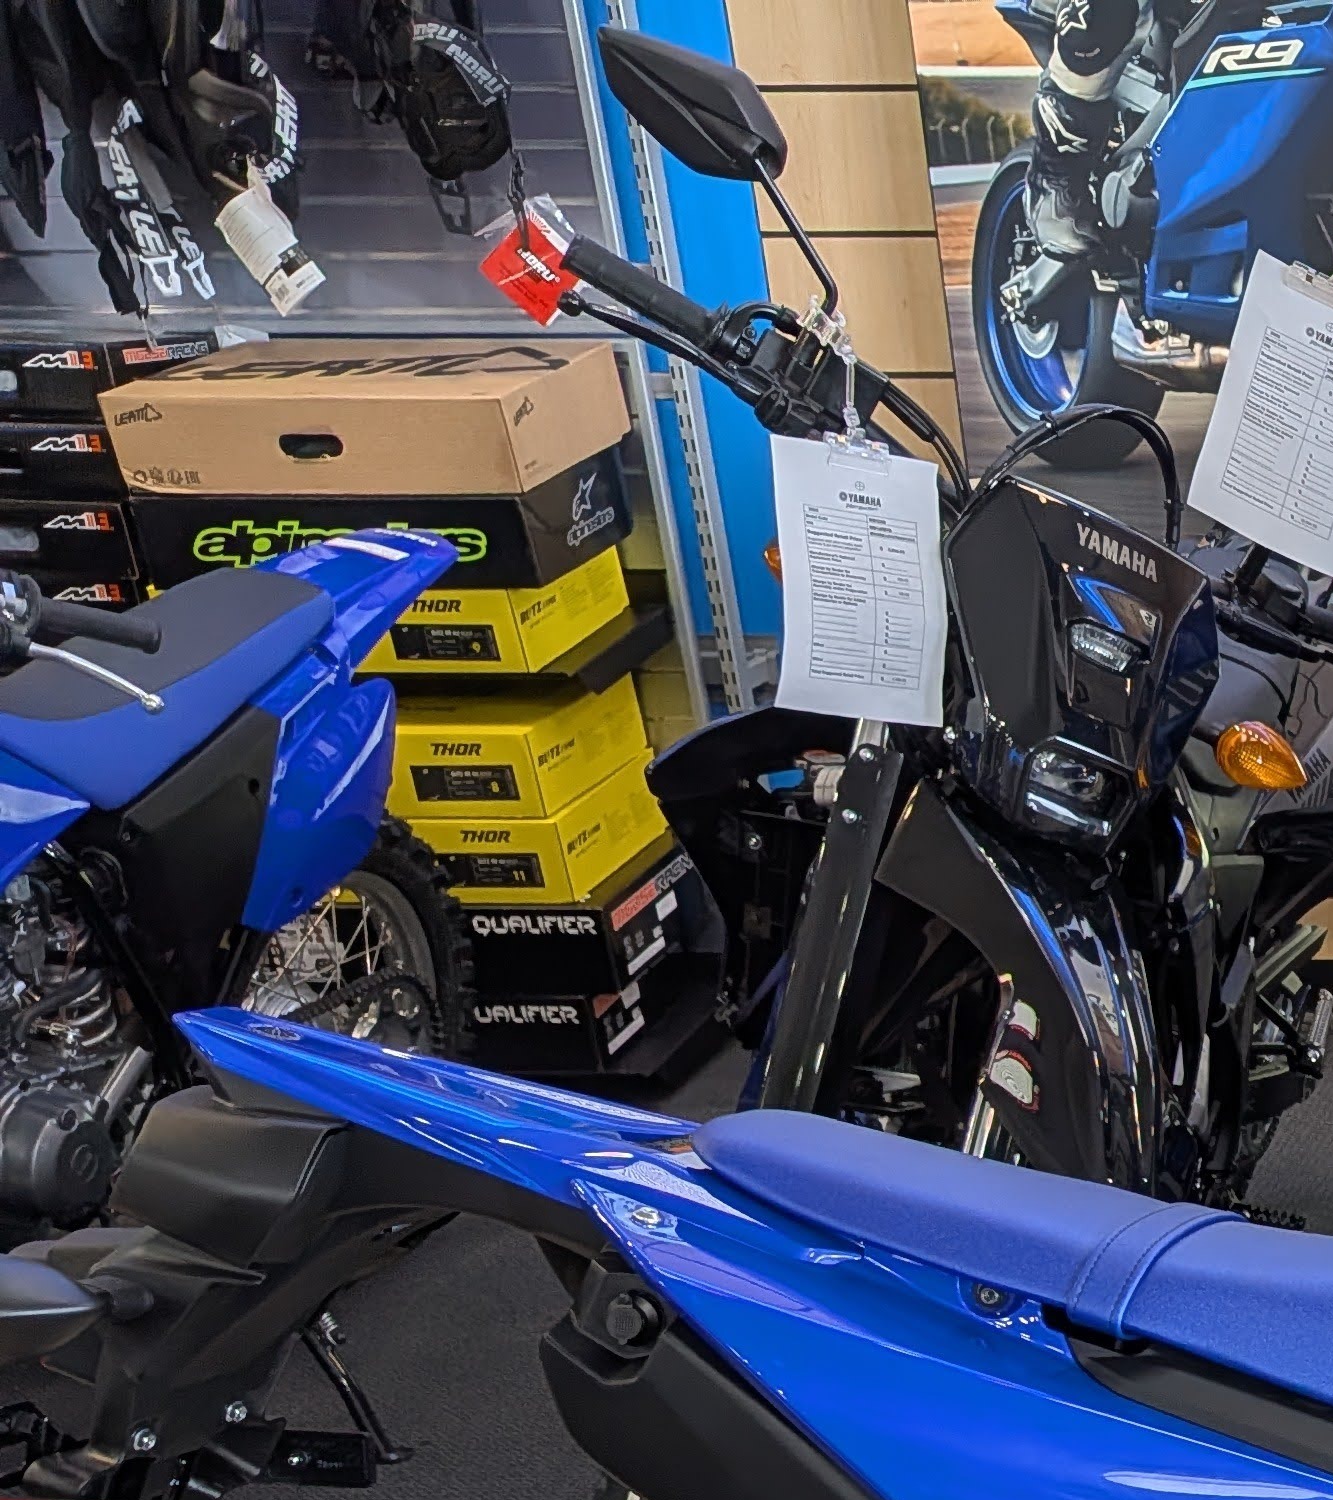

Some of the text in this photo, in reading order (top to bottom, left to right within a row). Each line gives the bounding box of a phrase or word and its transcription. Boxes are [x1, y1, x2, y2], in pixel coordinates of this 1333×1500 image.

[1203, 39, 1304, 74] R9
[849, 494, 882, 508] YAMAHA
[1077, 522, 1158, 583] YAMAHA
[412, 599, 462, 613] THOR
[431, 742, 483, 756] THOR
[460, 829, 512, 843] THOR
[472, 915, 598, 937] QUALIFIER
[474, 1005, 580, 1025] UALIFIER
